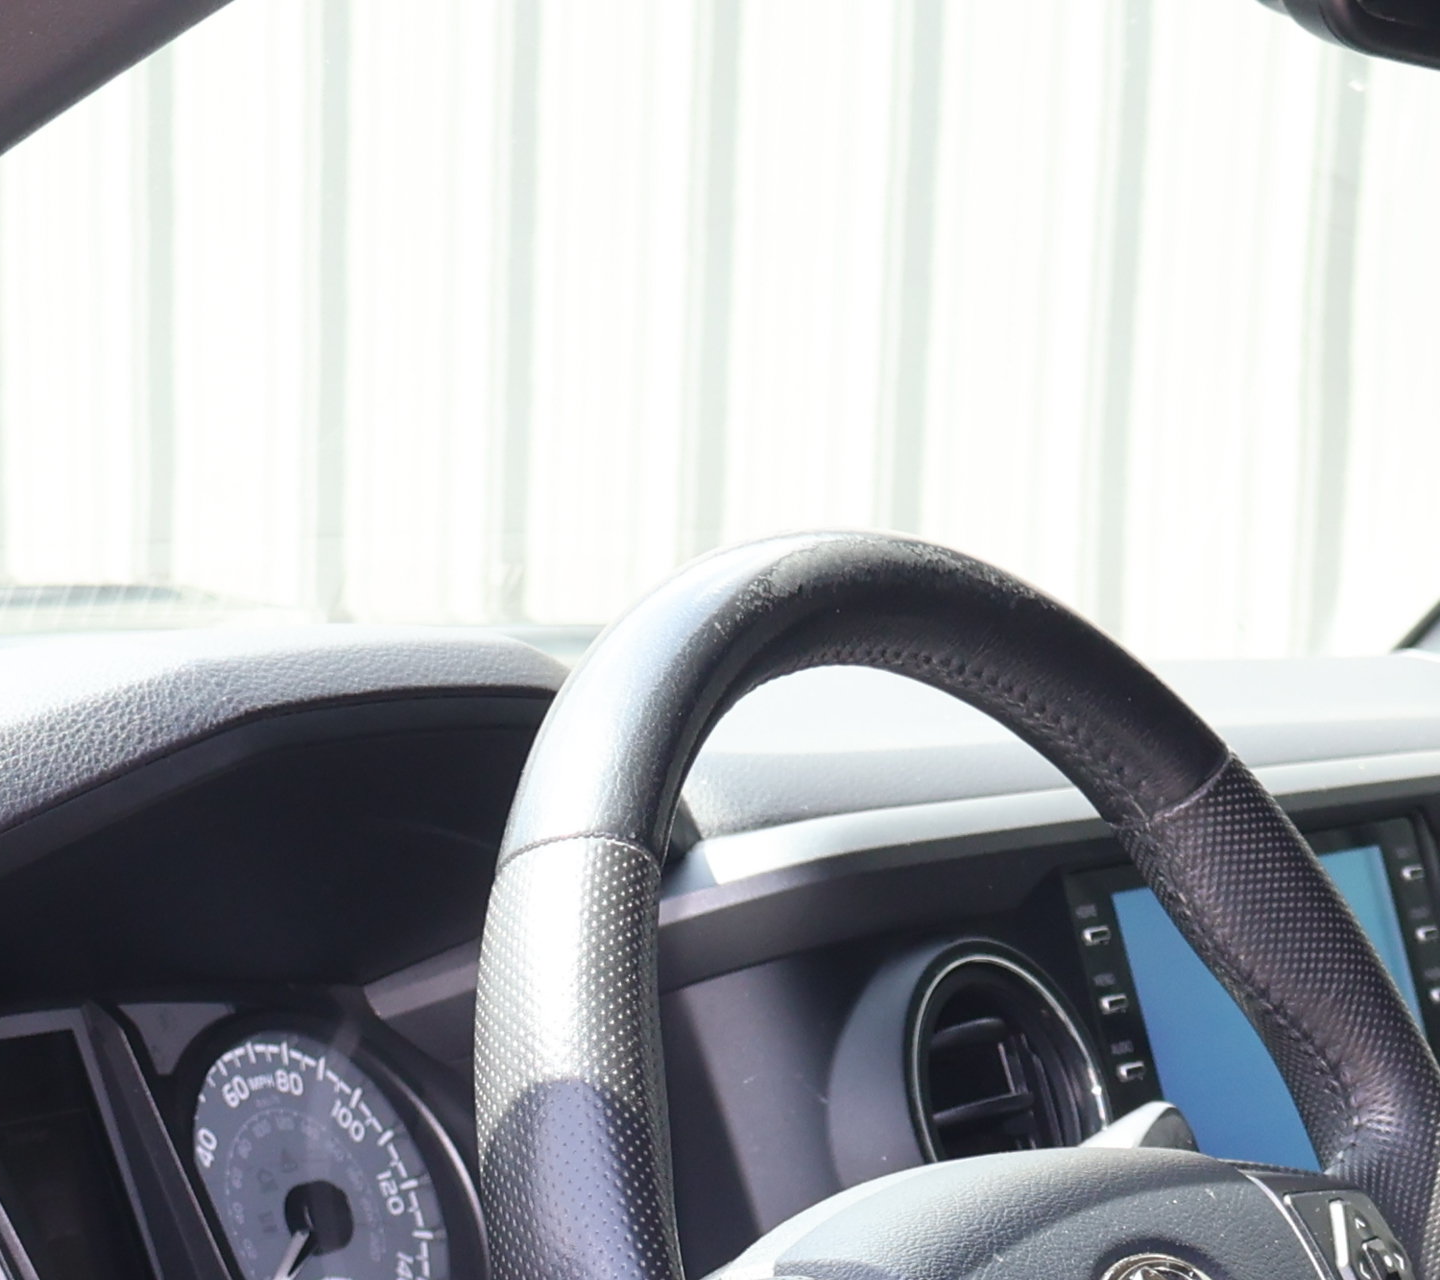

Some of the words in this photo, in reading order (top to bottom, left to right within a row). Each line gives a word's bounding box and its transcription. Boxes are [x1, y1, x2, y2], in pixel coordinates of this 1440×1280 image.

[222, 1075, 250, 1108] 60
[275, 1069, 304, 1096] 80
[331, 1099, 365, 1142] 100
[196, 1127, 219, 1168] 40
[376, 1170, 405, 1215] 120
